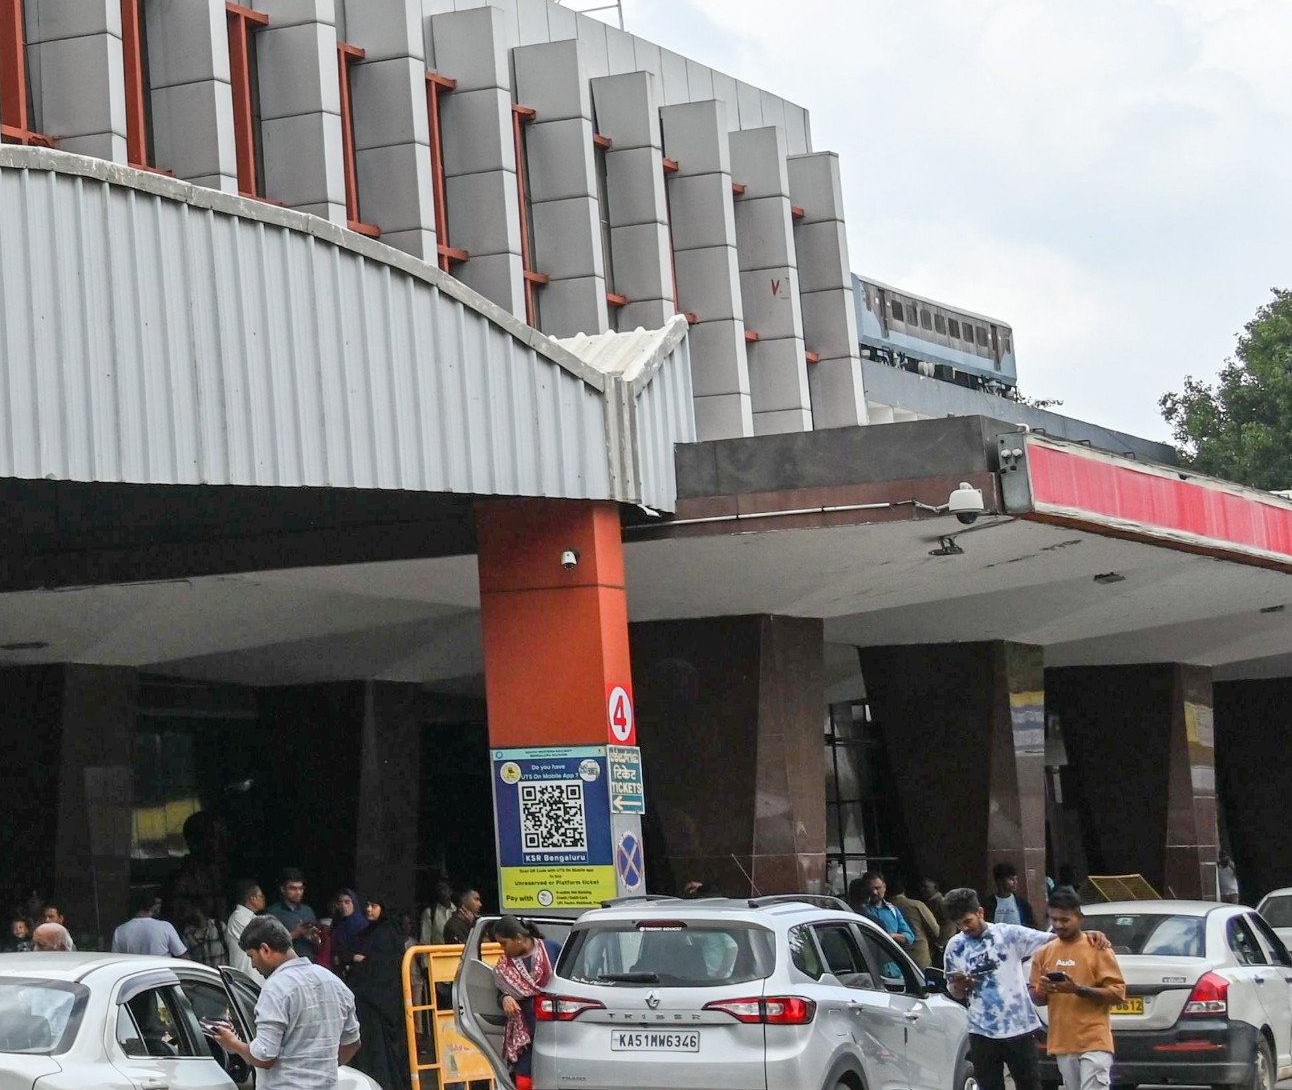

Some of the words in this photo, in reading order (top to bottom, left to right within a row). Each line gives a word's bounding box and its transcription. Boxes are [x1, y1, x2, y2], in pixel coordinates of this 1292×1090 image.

[613, 695, 626, 733] 4
[611, 781, 642, 795] TICKETS
[525, 854, 542, 862] KSR
[544, 853, 586, 864] Bengaluru
[506, 895, 518, 903] Pay
[519, 894, 534, 902] with
[1056, 958, 1076, 967] Audi
[607, 1013, 701, 1021] TRIBER
[619, 1033, 697, 1049] KA51MW6346
